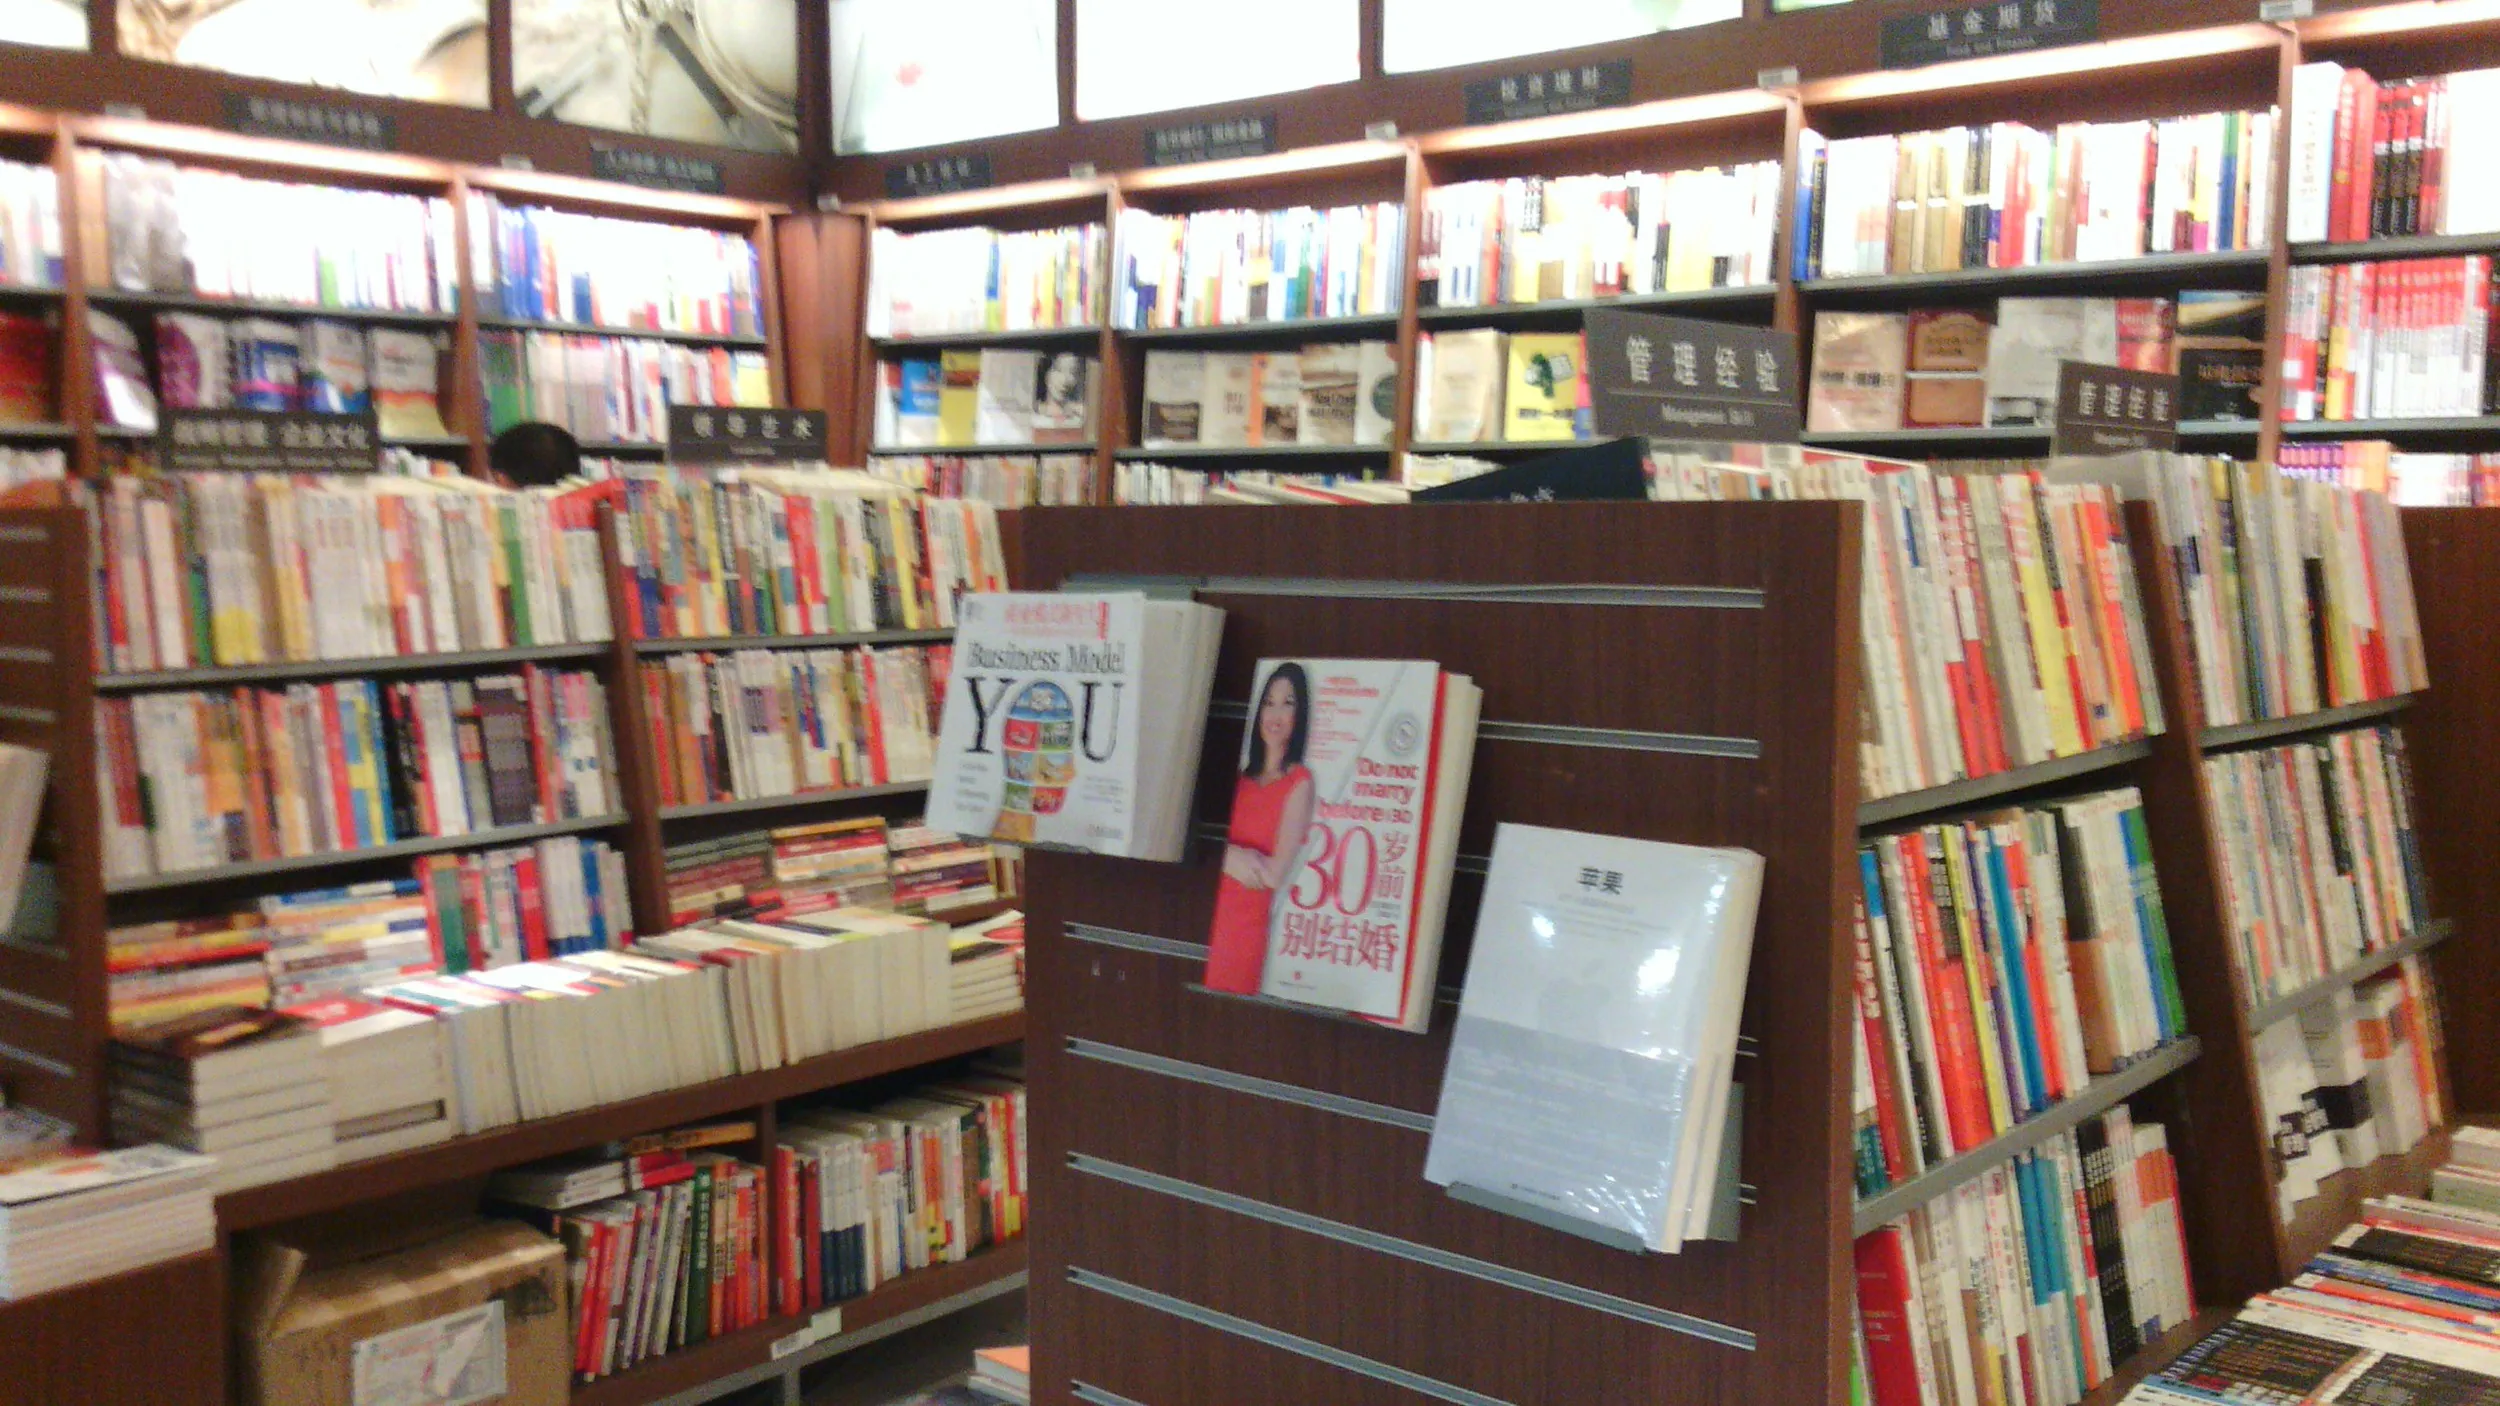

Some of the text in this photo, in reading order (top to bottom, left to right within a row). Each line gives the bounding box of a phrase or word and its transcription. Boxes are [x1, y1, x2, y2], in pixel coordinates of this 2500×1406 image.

[967, 640, 1126, 674] Business Model
[964, 675, 1125, 764] YOU
[1352, 782, 1416, 805] marry
[1289, 822, 1378, 917] 30
[1577, 866, 1624, 896] 苹果
[1280, 911, 1401, 973] 别结婚
